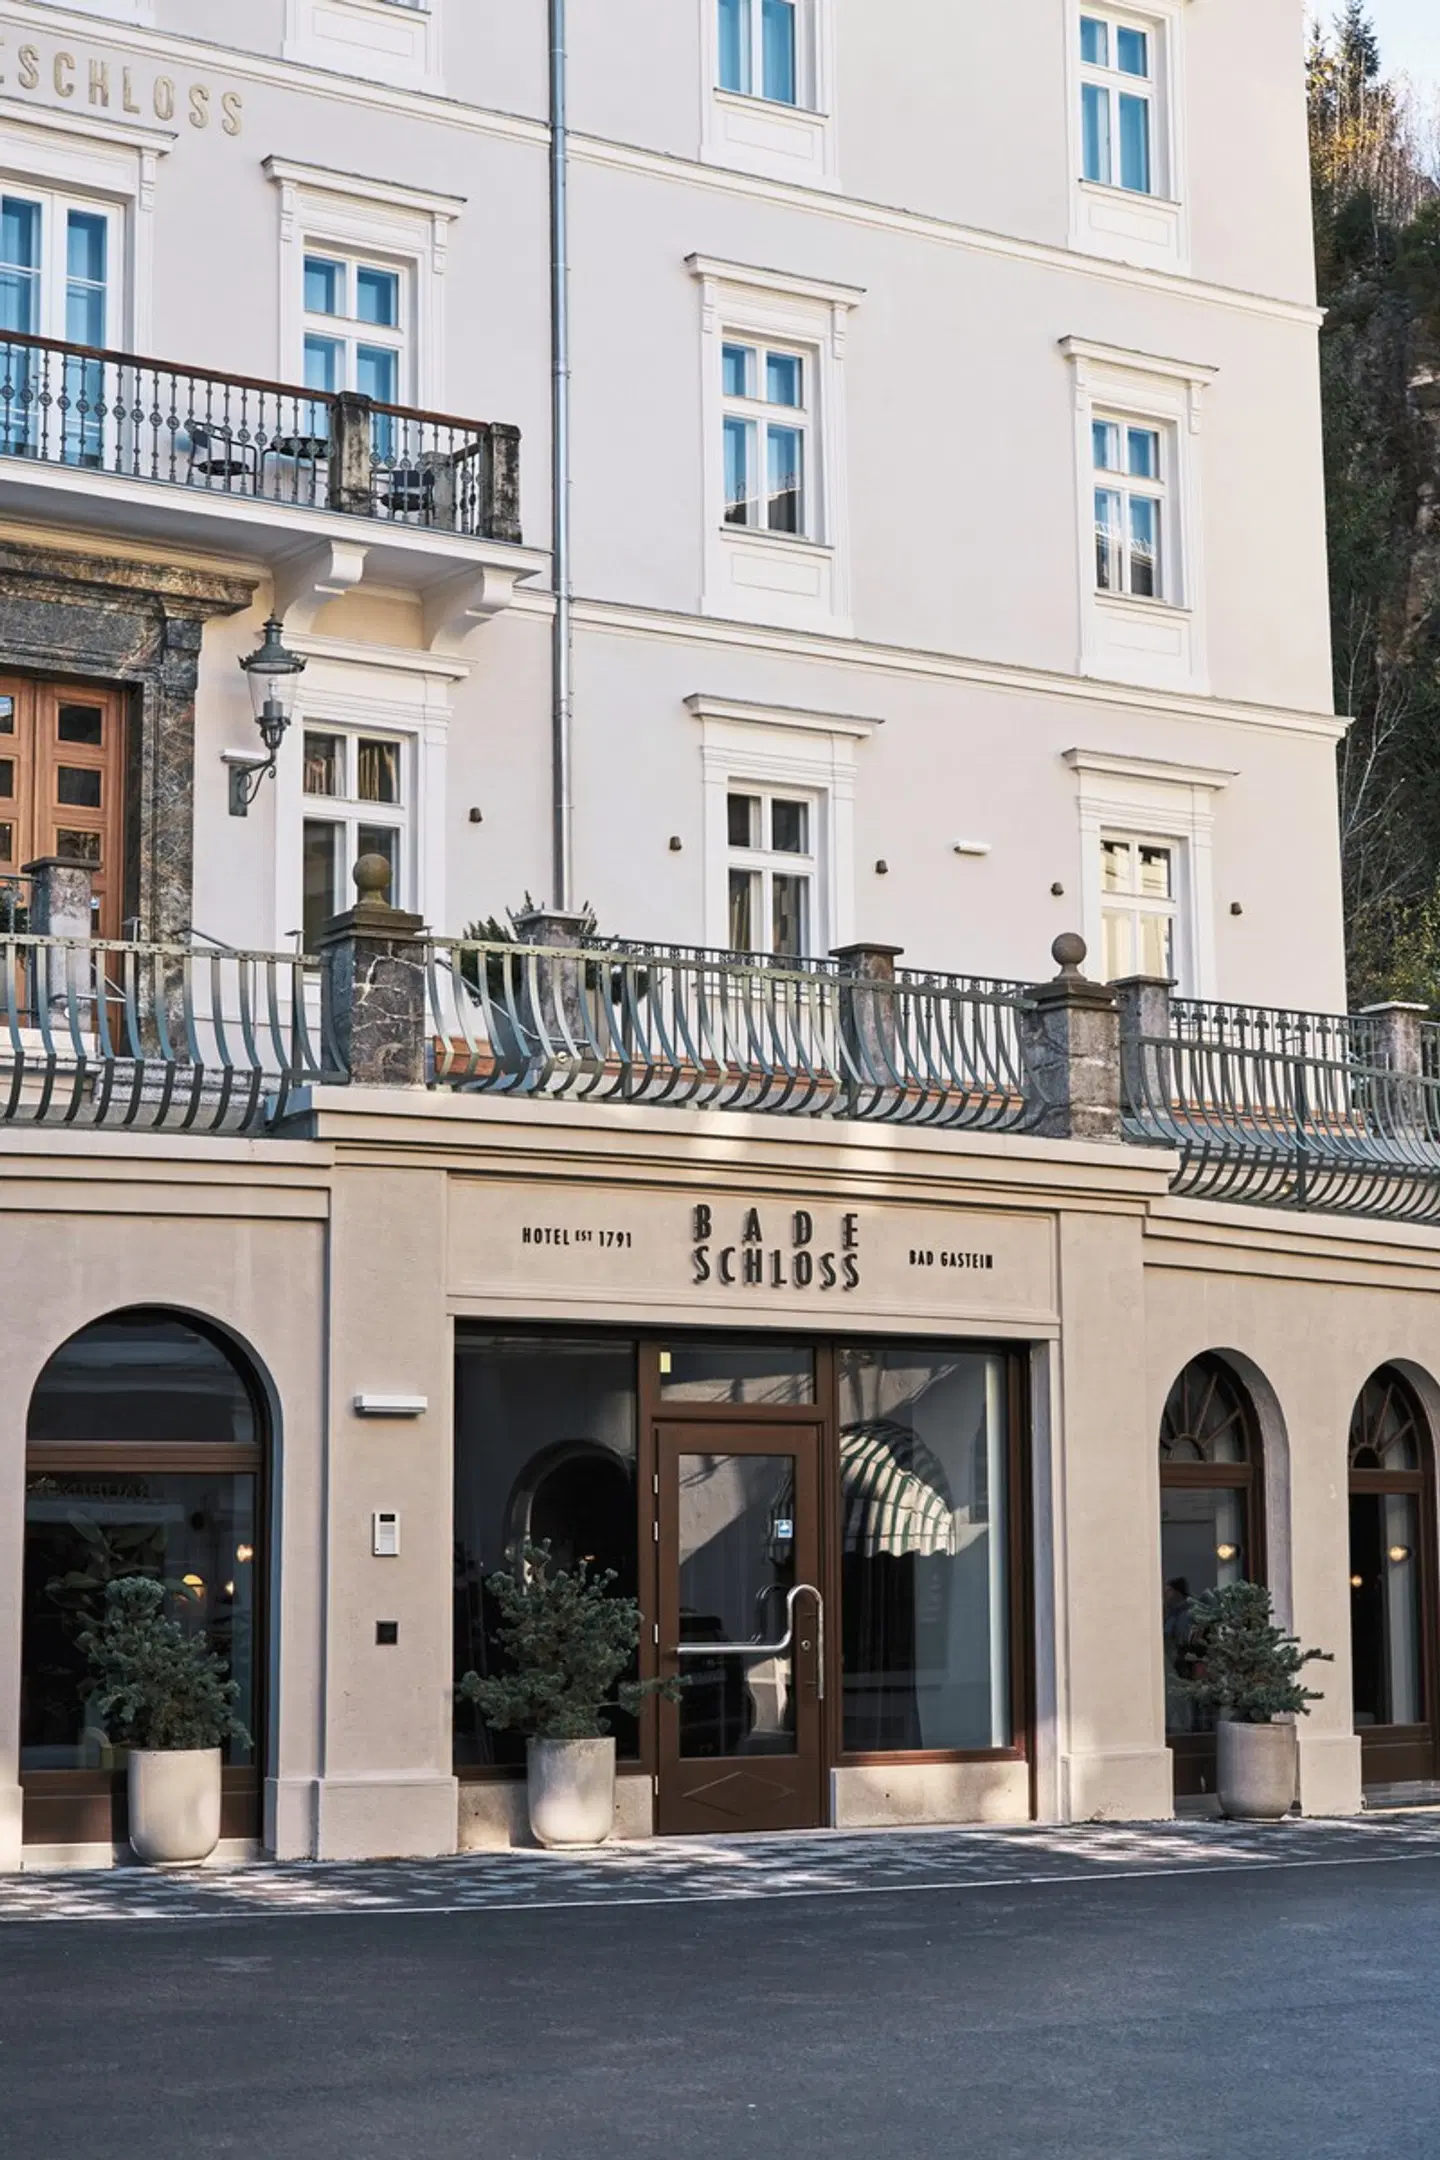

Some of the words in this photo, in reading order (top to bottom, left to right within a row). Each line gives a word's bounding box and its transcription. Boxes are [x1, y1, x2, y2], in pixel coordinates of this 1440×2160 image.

[0, 36, 243, 136] SCHLOSS
[522, 1227, 570, 1245] HOTEL
[575, 1229, 592, 1242] EST
[599, 1231, 632, 1248] 1791
[693, 1204, 859, 1249] BADE
[693, 1245, 860, 1290] SCHLOSS
[909, 1249, 934, 1266] BAD
[940, 1251, 993, 1269] GASTEIN
